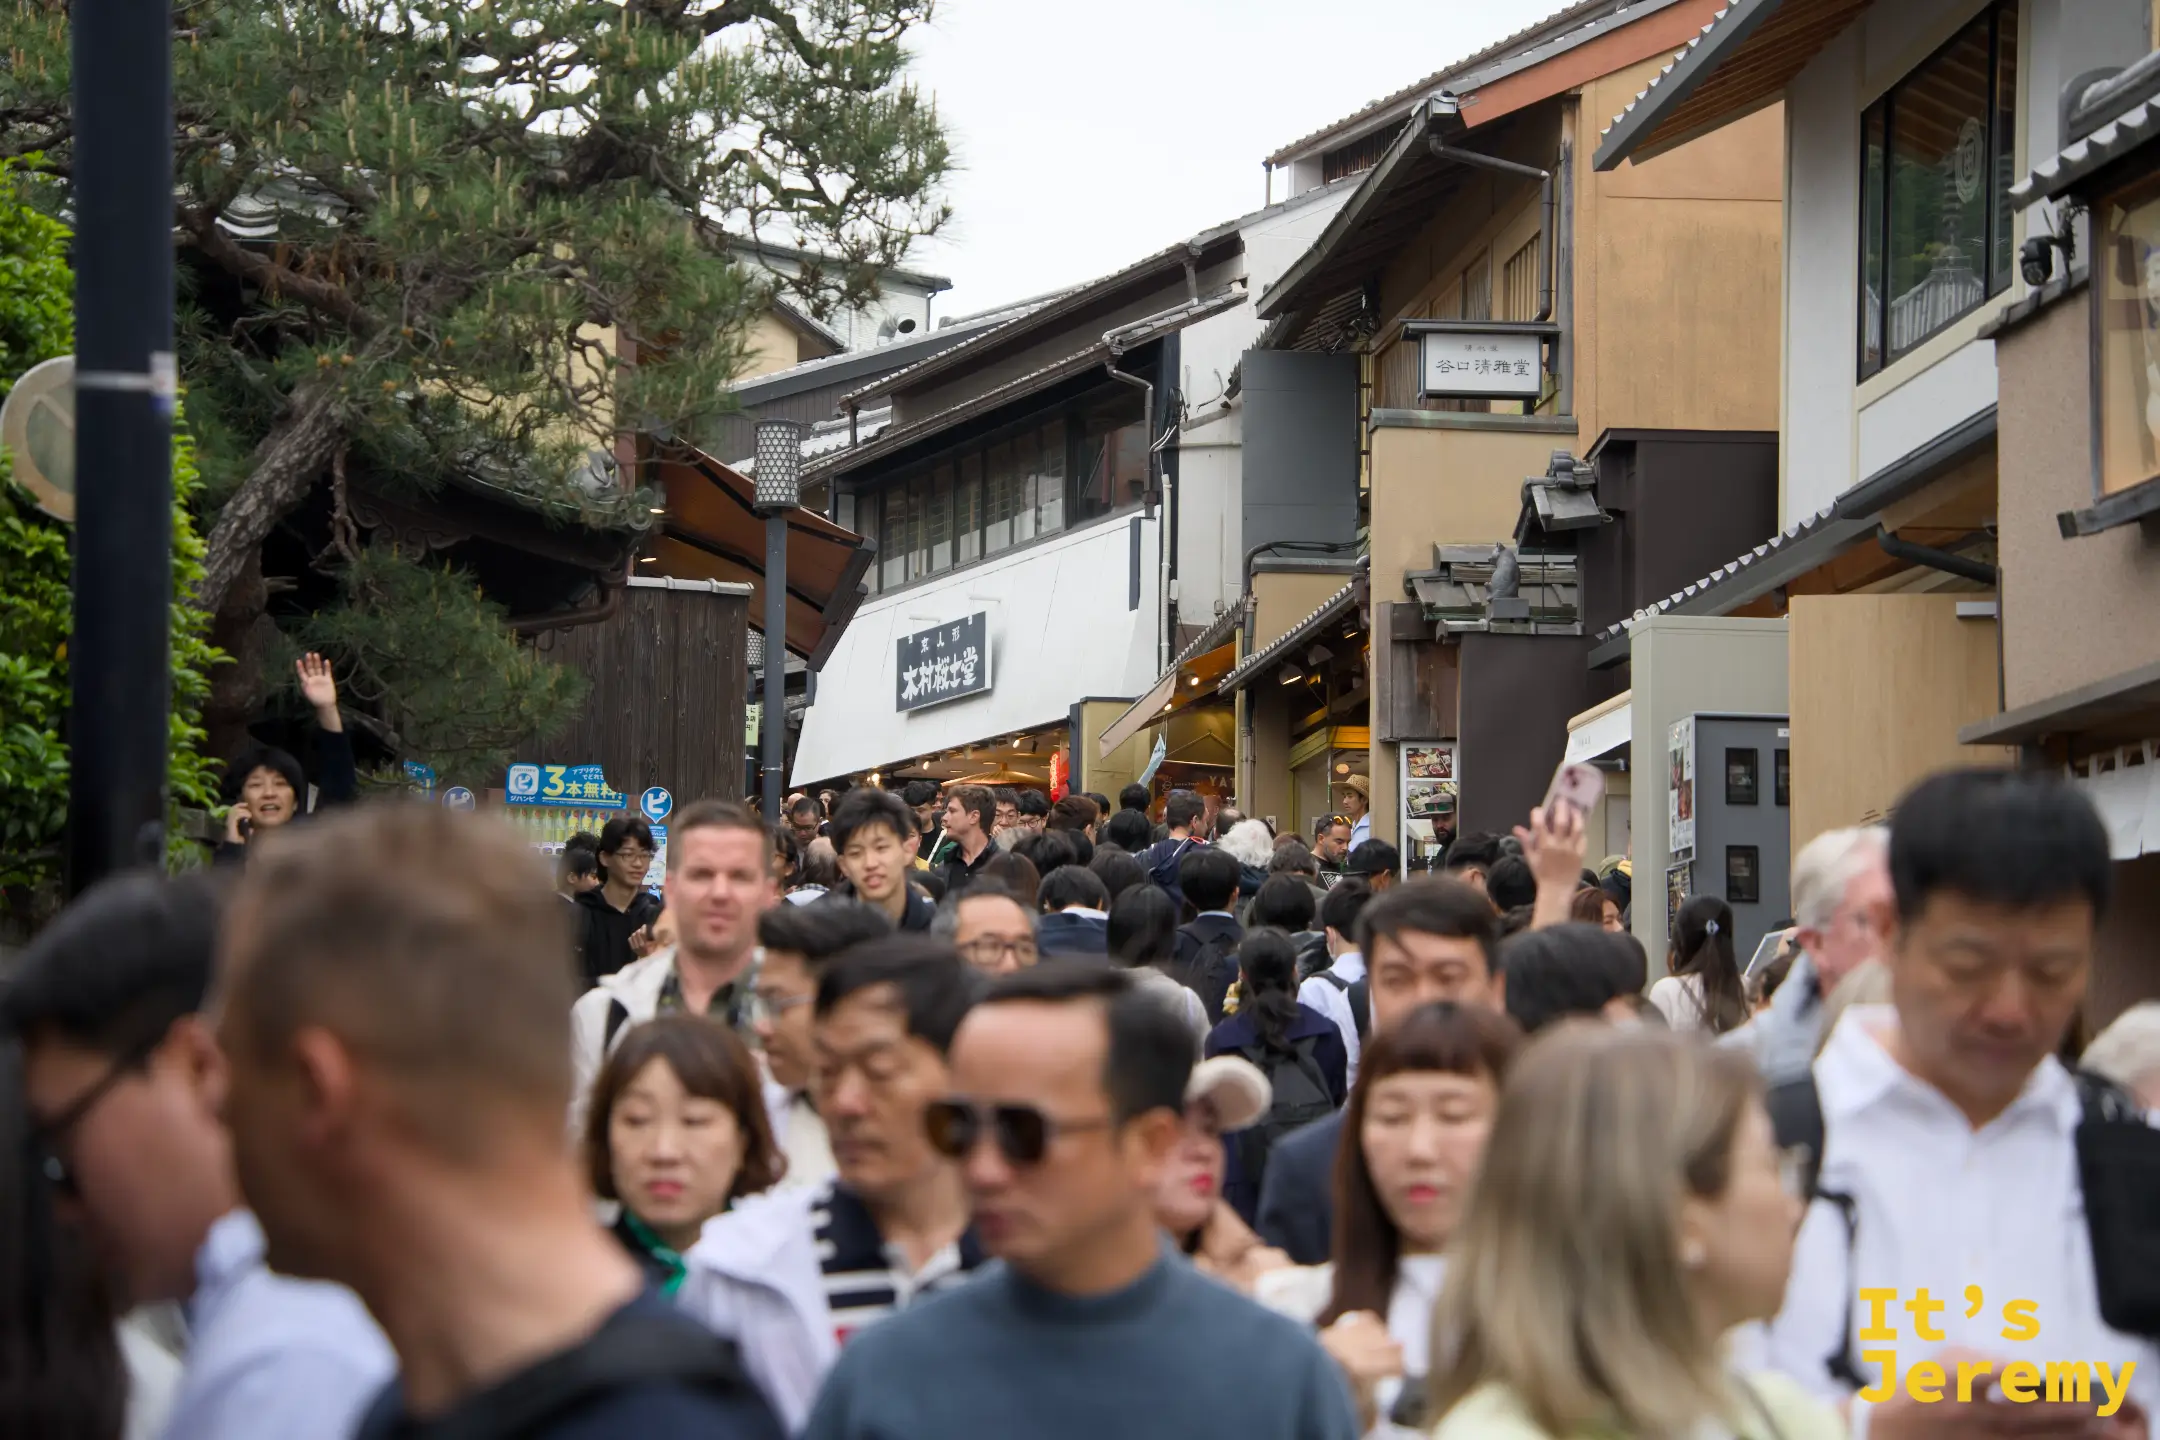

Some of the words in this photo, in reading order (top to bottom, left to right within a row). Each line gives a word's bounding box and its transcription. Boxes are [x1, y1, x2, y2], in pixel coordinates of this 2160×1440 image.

[1436, 358, 1531, 376] 谷口清雅堂
[921, 625, 961, 653] 京人形
[510, 795, 536, 803] ジハンピ
